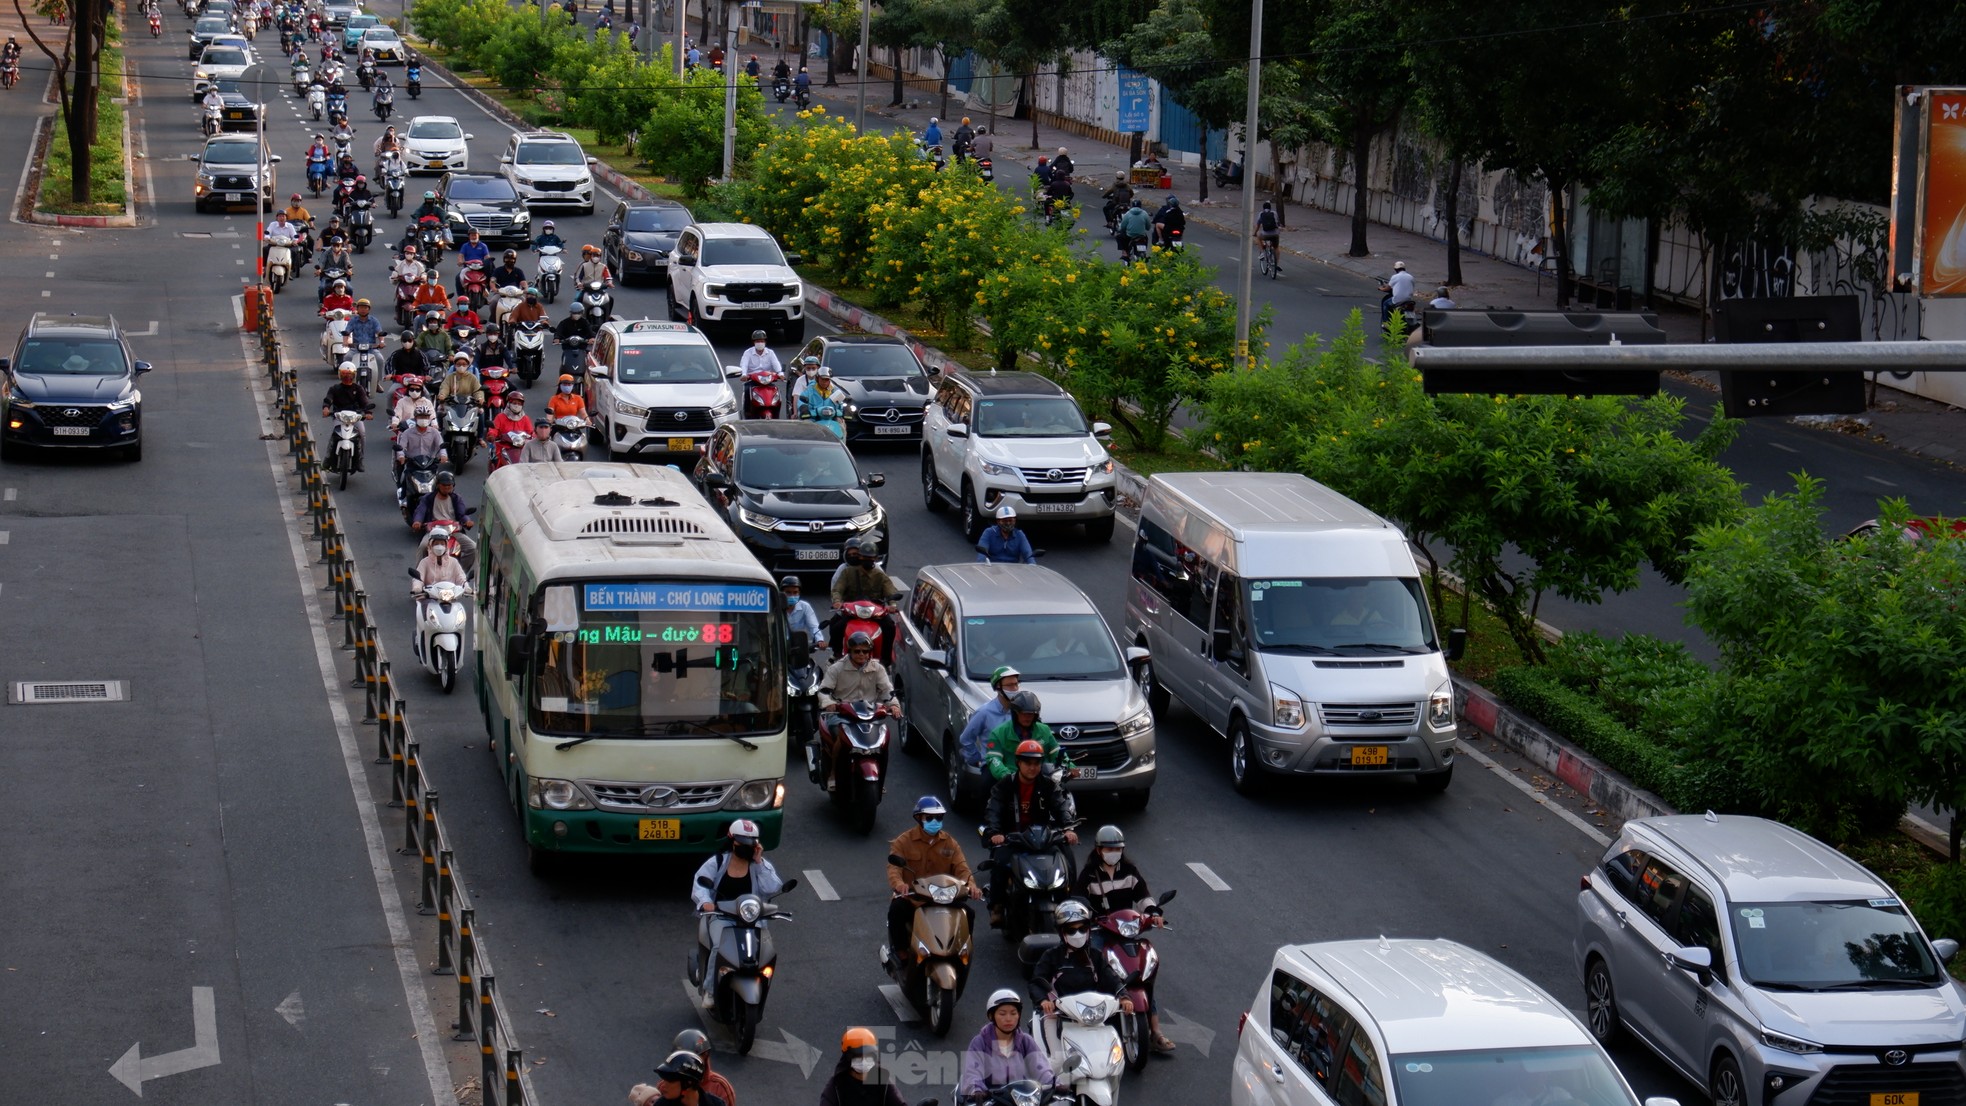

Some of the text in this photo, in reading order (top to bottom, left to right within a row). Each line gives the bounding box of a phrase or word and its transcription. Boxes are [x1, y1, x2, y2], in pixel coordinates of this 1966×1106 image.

[590, 587, 614, 605] BẾN
[617, 588, 656, 605] THÀNH
[667, 590, 692, 607] CHỢ
[694, 592, 724, 606] LONG
[727, 590, 765, 607] PHƯỚC
[702, 624, 733, 644] 88
[1362, 747, 1378, 755] 49B
[650, 820, 668, 829] 51B
[643, 830, 676, 839] 248.13
[1884, 1094, 1905, 1105] 60K
